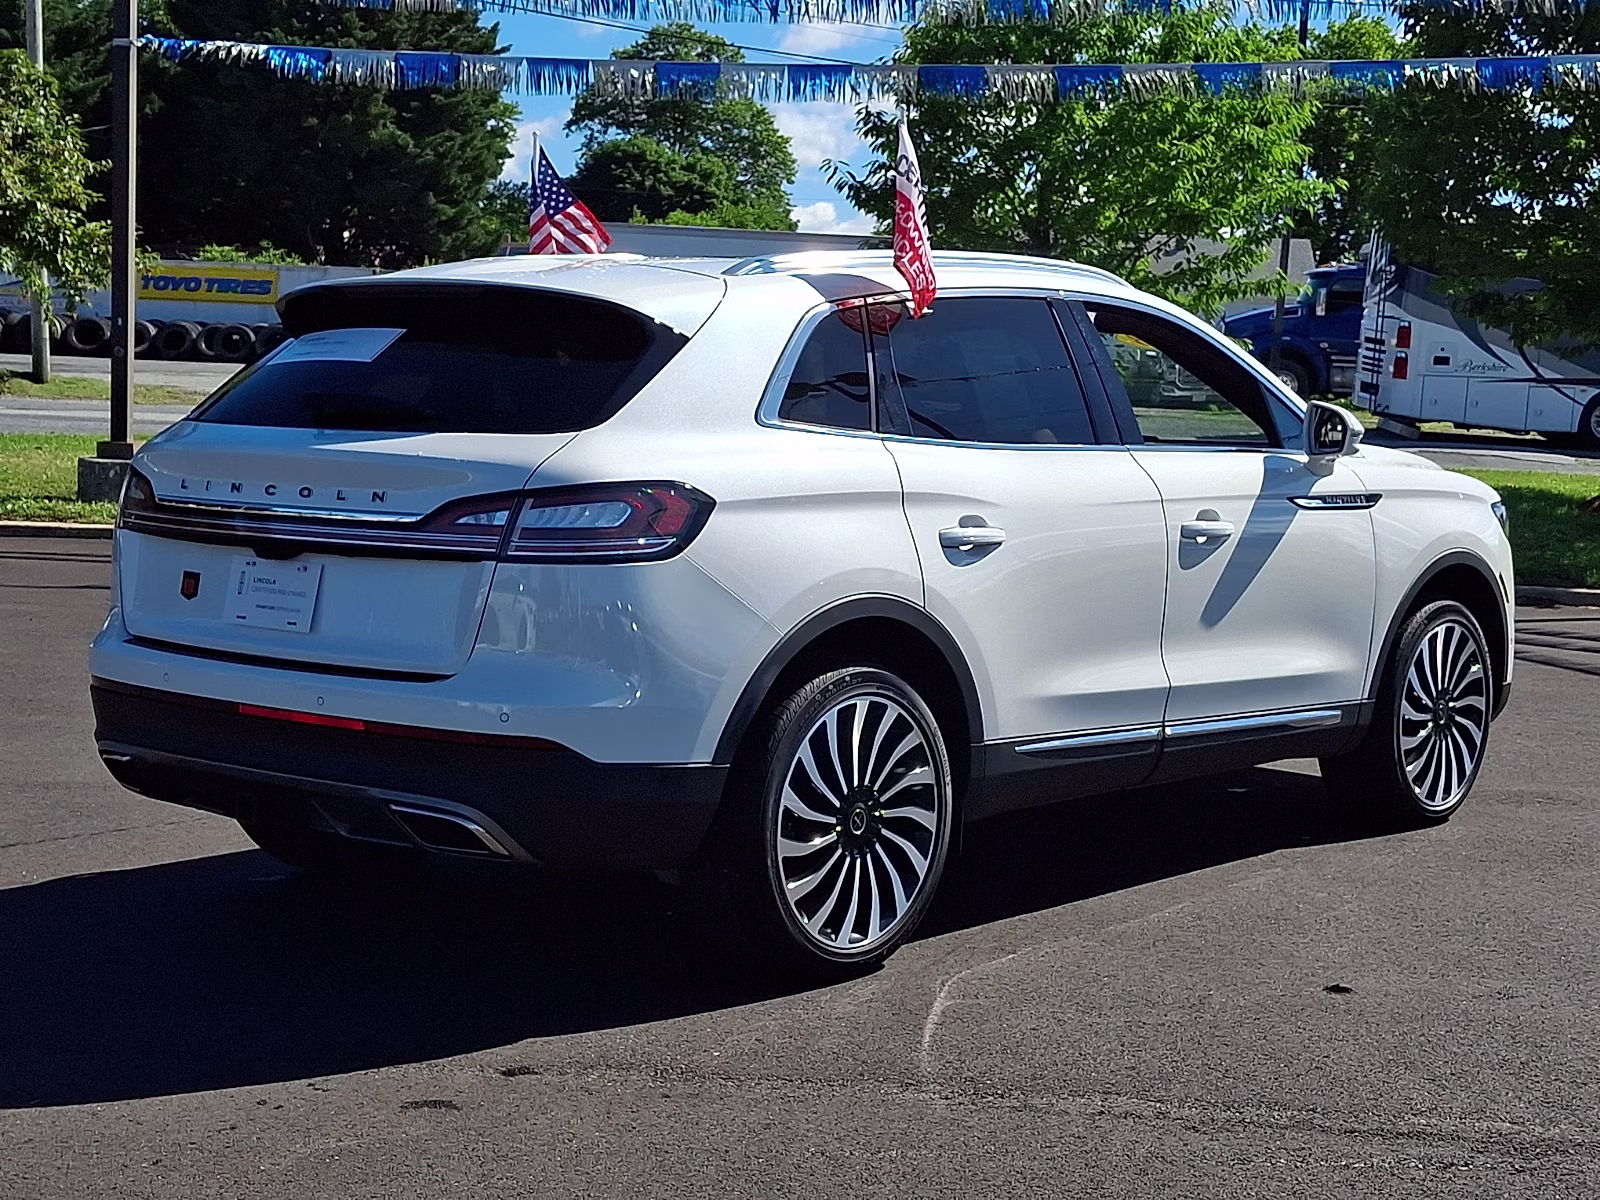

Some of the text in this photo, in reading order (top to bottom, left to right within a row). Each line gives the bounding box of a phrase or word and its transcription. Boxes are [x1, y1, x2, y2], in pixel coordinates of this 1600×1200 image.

[141, 275, 273, 295] TOYO TIRES
[1457, 358, 1508, 374] Berkshire
[181, 479, 387, 502] LINCOLN
